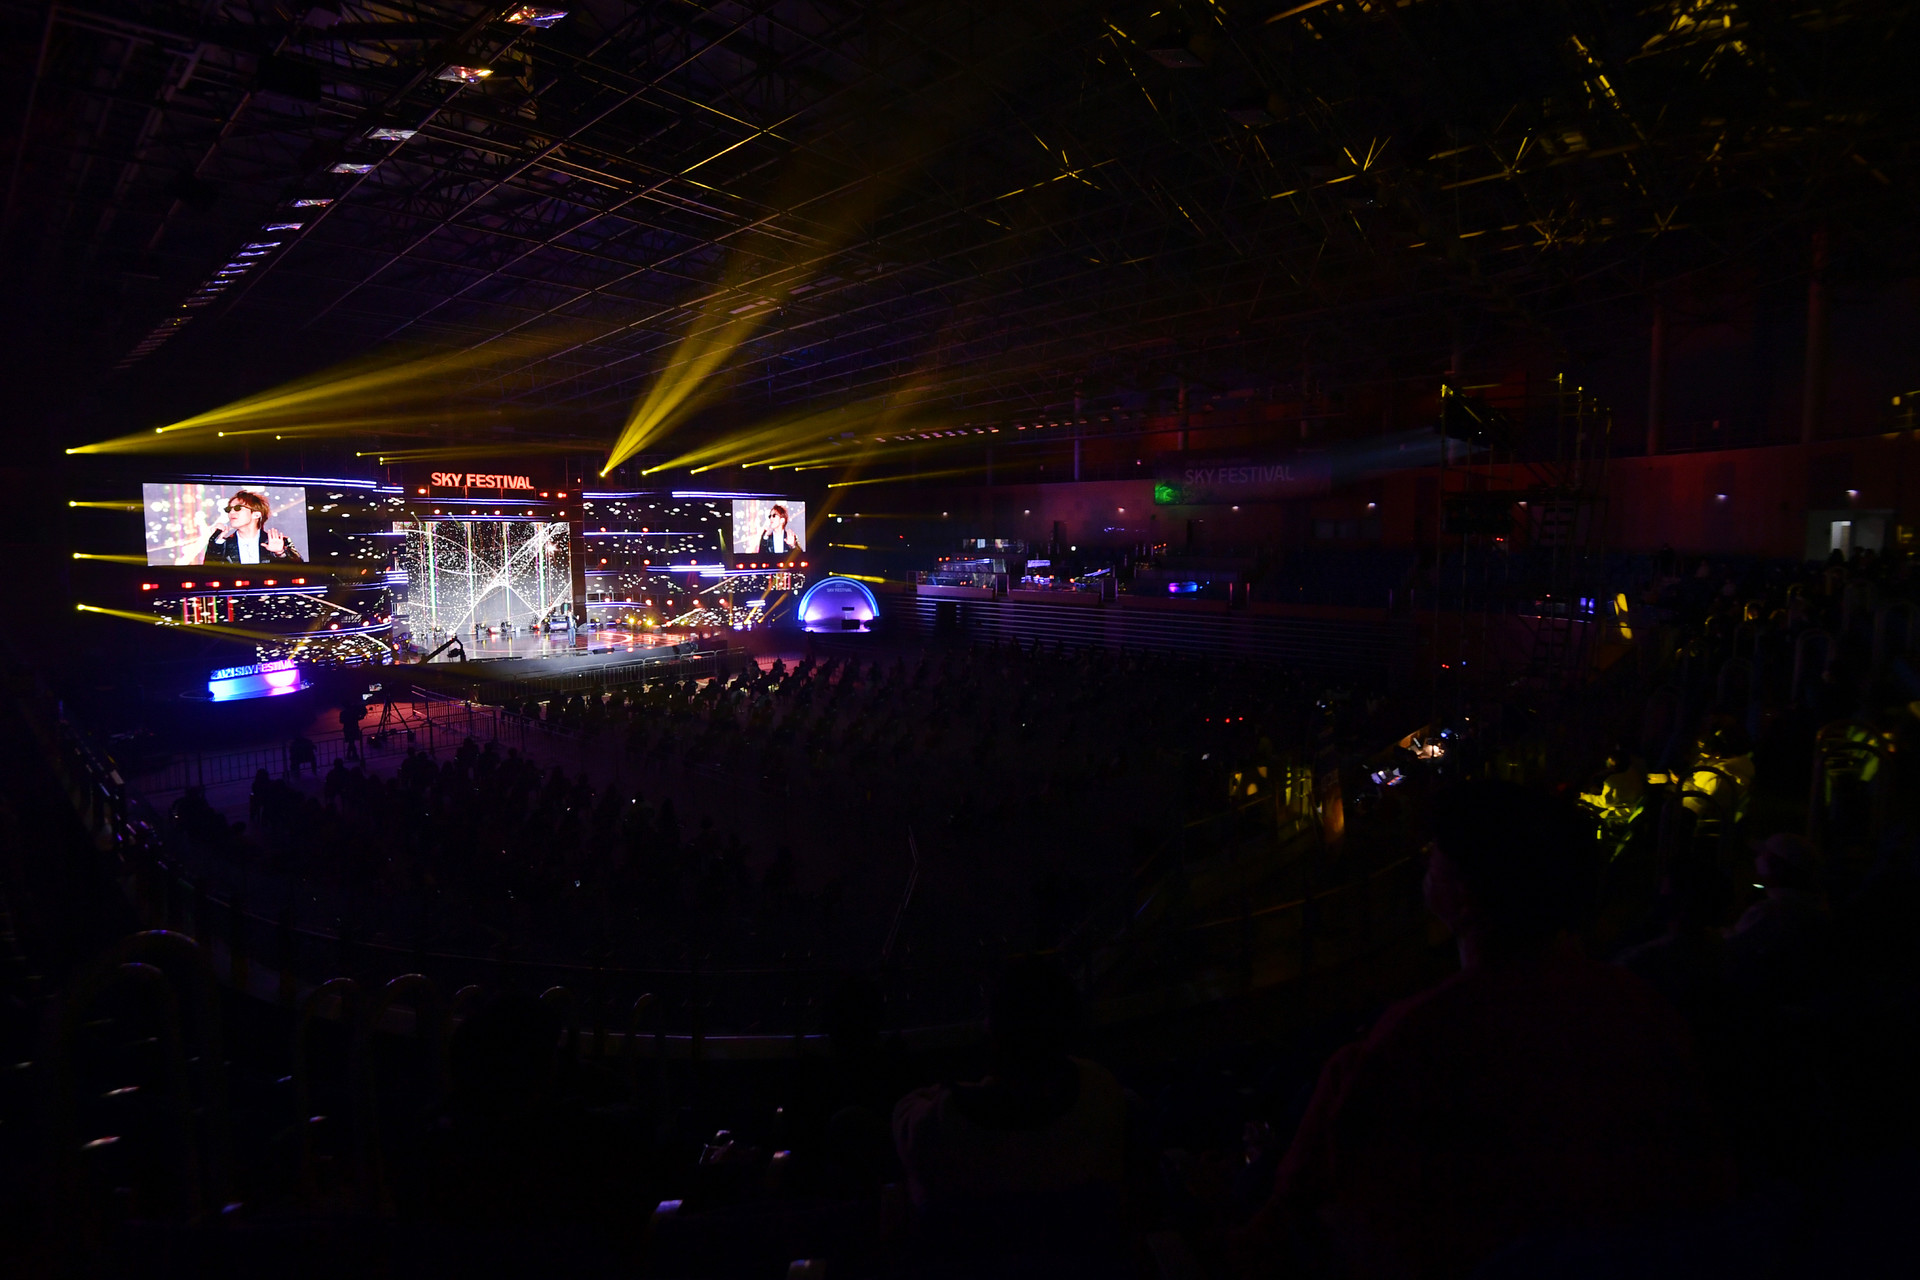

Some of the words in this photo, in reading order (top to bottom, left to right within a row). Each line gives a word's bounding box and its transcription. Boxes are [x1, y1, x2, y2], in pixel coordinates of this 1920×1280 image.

[431, 472, 463, 487] SKY
[466, 473, 535, 489] FESTIVAL
[1184, 468, 1215, 485] SKY
[1218, 465, 1294, 484] FESTIVAL
